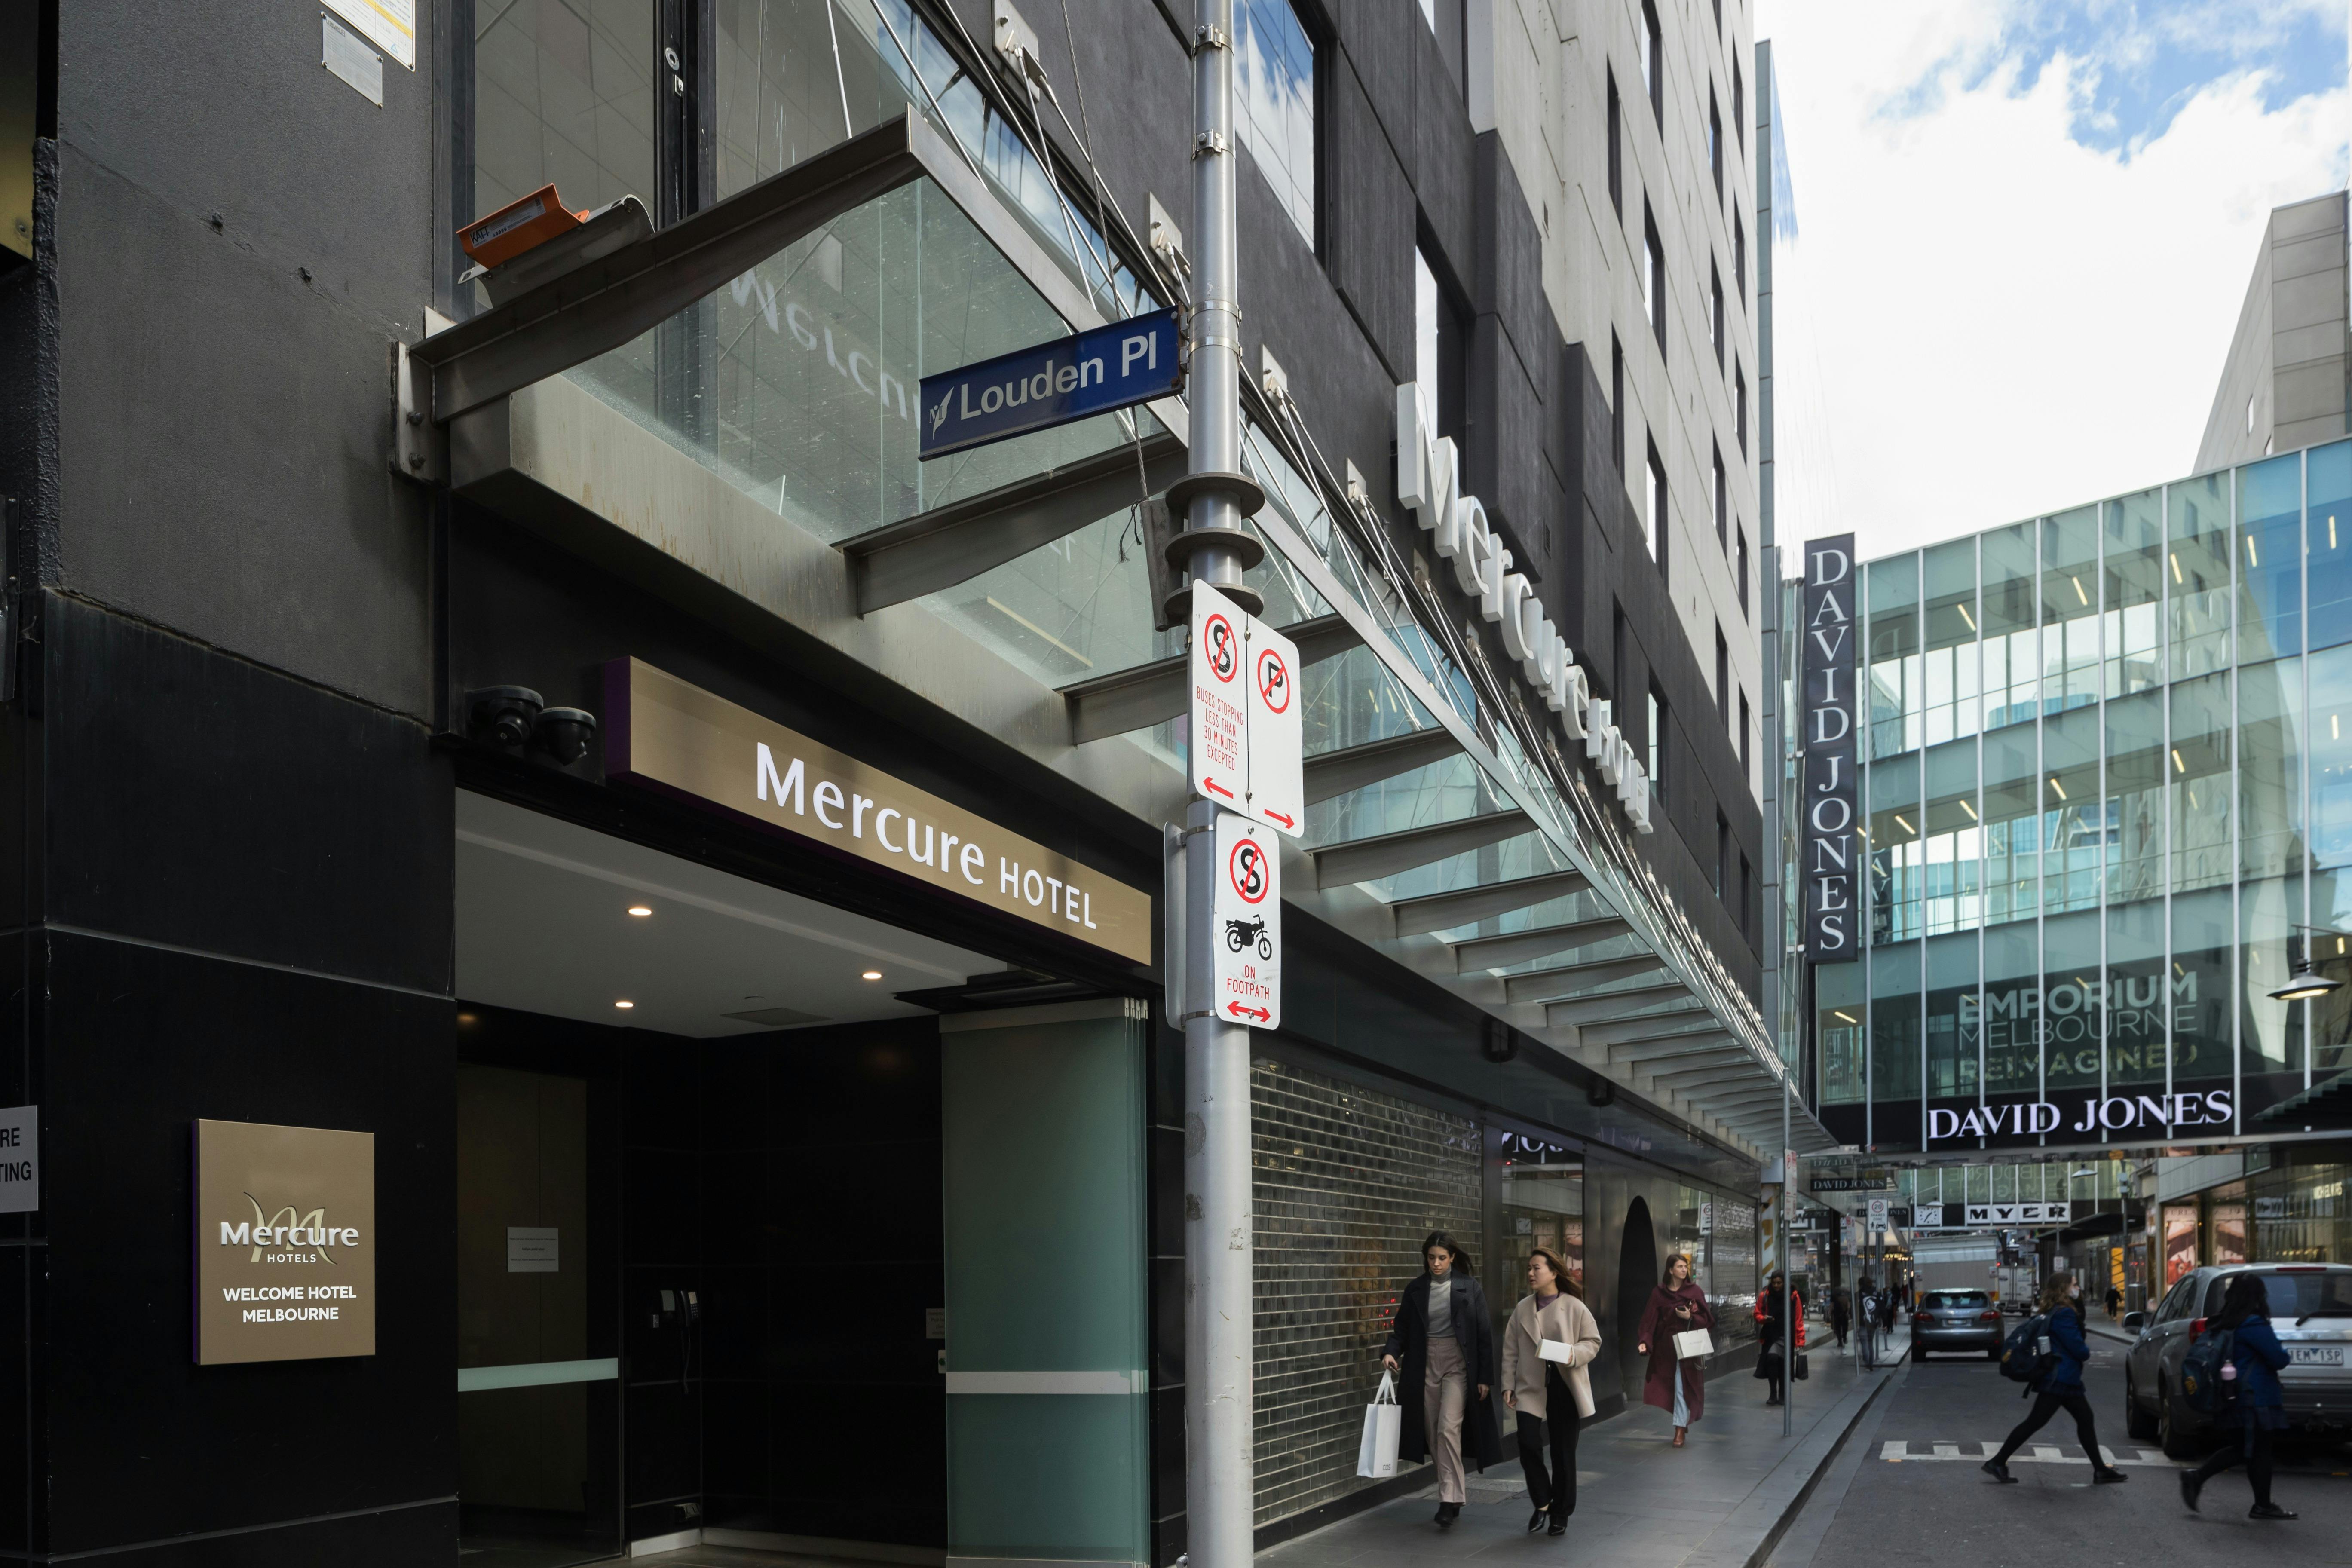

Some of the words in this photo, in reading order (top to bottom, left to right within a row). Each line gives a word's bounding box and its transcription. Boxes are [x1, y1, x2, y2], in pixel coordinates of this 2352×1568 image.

[961, 359, 1103, 420] Louden
[1122, 331, 1157, 377] Pl
[1397, 381, 1589, 740] Mercure
[1811, 549, 1849, 743] DAVID
[1197, 686, 1215, 708] BUSES
[1217, 698, 1243, 726] STOPPING
[1205, 708, 1219, 728] LESS
[1222, 717, 1236, 738] THAN
[1204, 725, 1211, 741] 30
[1214, 730, 1237, 755] MINUTES
[1207, 744, 1235, 770] EXCEPTED
[757, 742, 985, 885] Mercure
[1000, 857, 1096, 930] HOTEL
[1811, 755, 1851, 951] JONES
[1244, 965, 1255, 980] ON
[1227, 978, 1269, 1000] FOOTPATH
[1959, 971, 2197, 1025] EMPORIUM
[1959, 1004, 2198, 1051] MELBOURNE
[1928, 1102, 2061, 1139] DAVID
[2074, 1090, 2233, 1133] JONES
[1814, 1181, 1847, 1189] DAVID
[1849, 1179, 1884, 1188] JONES
[1969, 1207, 2066, 1220] MYER
[220, 1222, 359, 1246] Mercure
[267, 1254, 317, 1263] HOTELS
[223, 1287, 304, 1302] WELCOME
[308, 1286, 357, 1299] HOTEL
[243, 1307, 339, 1323] MELBOURNE
